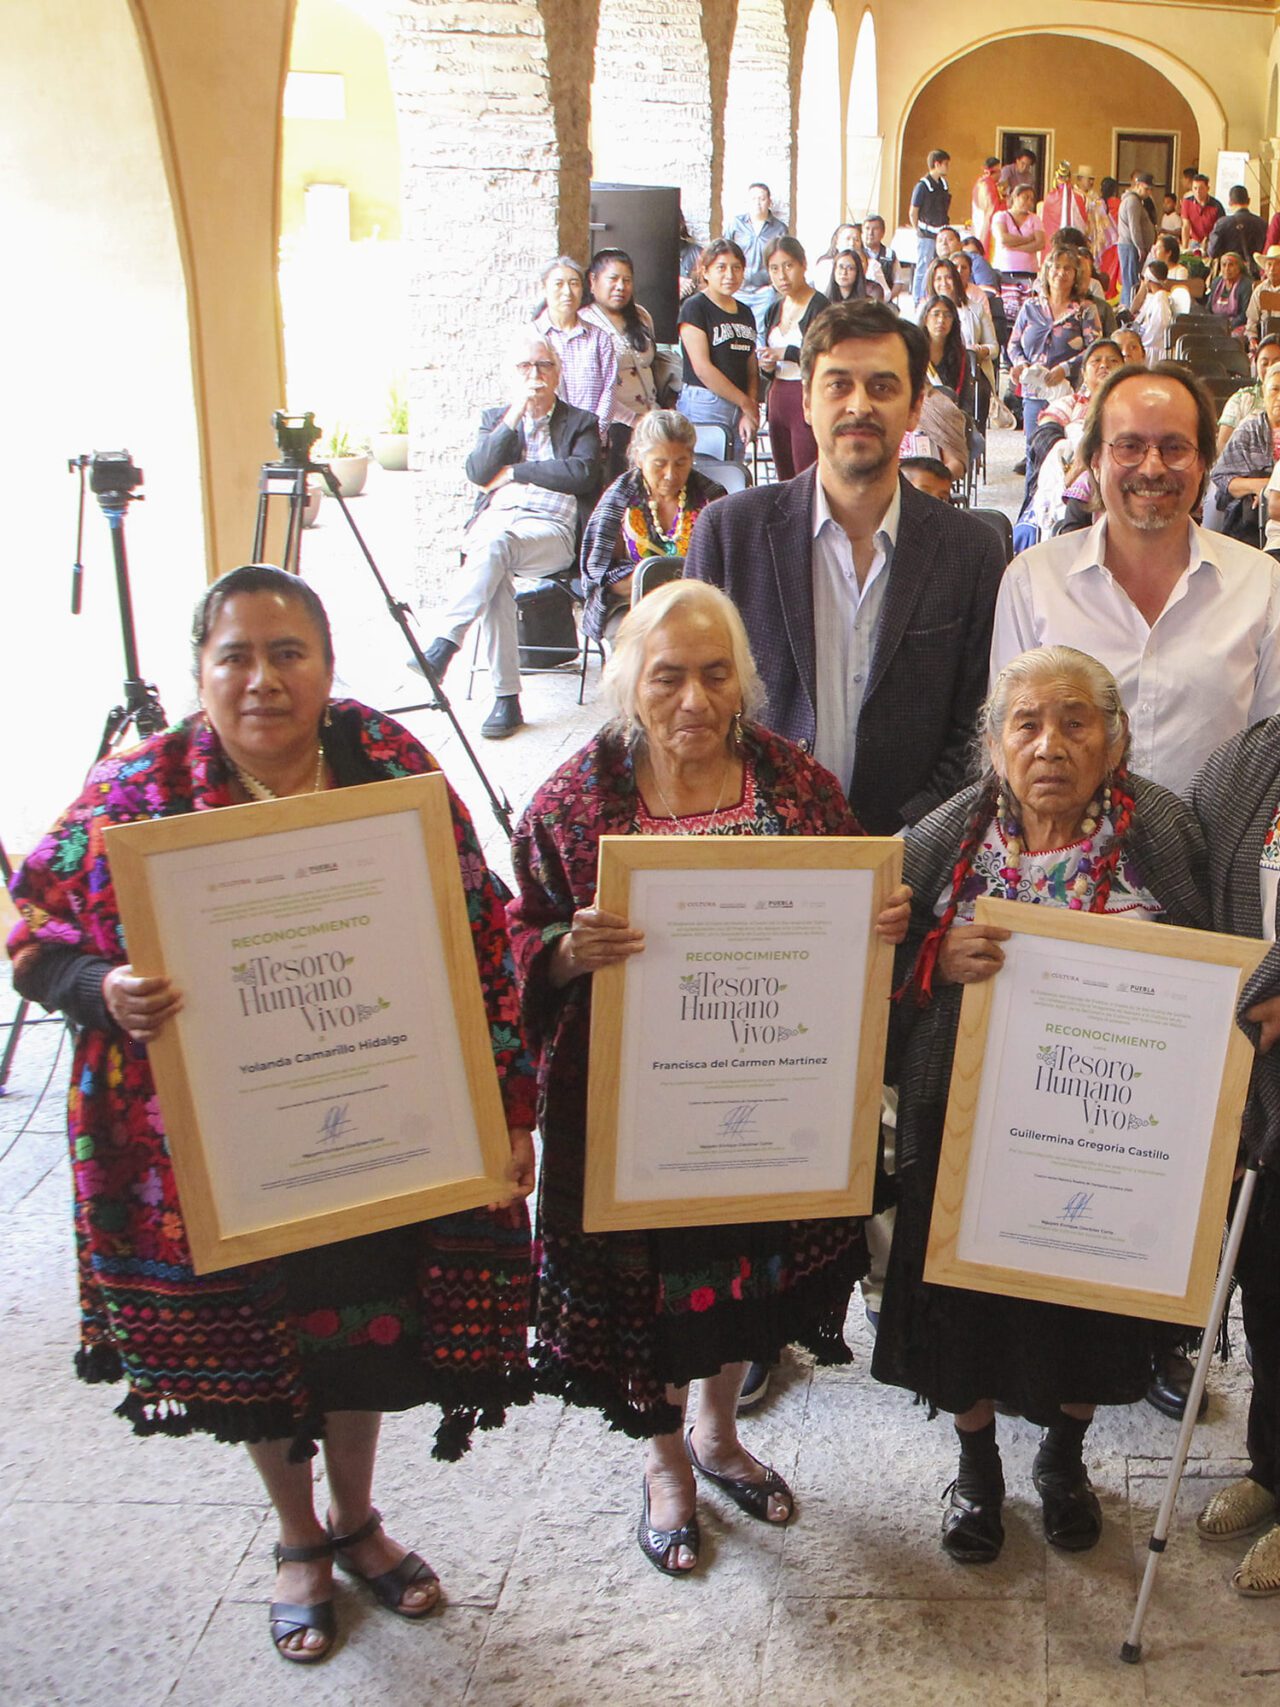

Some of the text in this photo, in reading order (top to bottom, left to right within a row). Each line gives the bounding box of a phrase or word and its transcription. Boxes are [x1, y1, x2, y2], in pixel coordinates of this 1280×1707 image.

[712, 322, 735, 347] LAS
[231, 915, 371, 949] RECONOCIMIENTO
[250, 950, 346, 986] Tesoro
[686, 950, 809, 962] RECONOCIMIENTO
[239, 976, 352, 1016] Humano
[698, 972, 779, 997] Tesoro
[1130, 984, 1155, 993] PUEBLA
[301, 1005, 355, 1032] Vivo
[680, 996, 779, 1021] Humano
[731, 1020, 775, 1044] Vivo
[1045, 1023, 1167, 1051] RECONOCIMIENTO
[240, 1057, 292, 1074] Yolanda
[296, 1045, 356, 1063] Camarillo
[359, 1034, 408, 1051] Hidalgo
[653, 1060, 708, 1070] Francisca
[711, 1059, 728, 1069] del
[732, 1058, 776, 1068] Carmen
[1056, 1044, 1134, 1082] Tesoro
[1035, 1066, 1132, 1105] Humano
[1083, 1099, 1126, 1130] Vivo
[1010, 1128, 1170, 1161] Guillermina Gregoria Castillo
